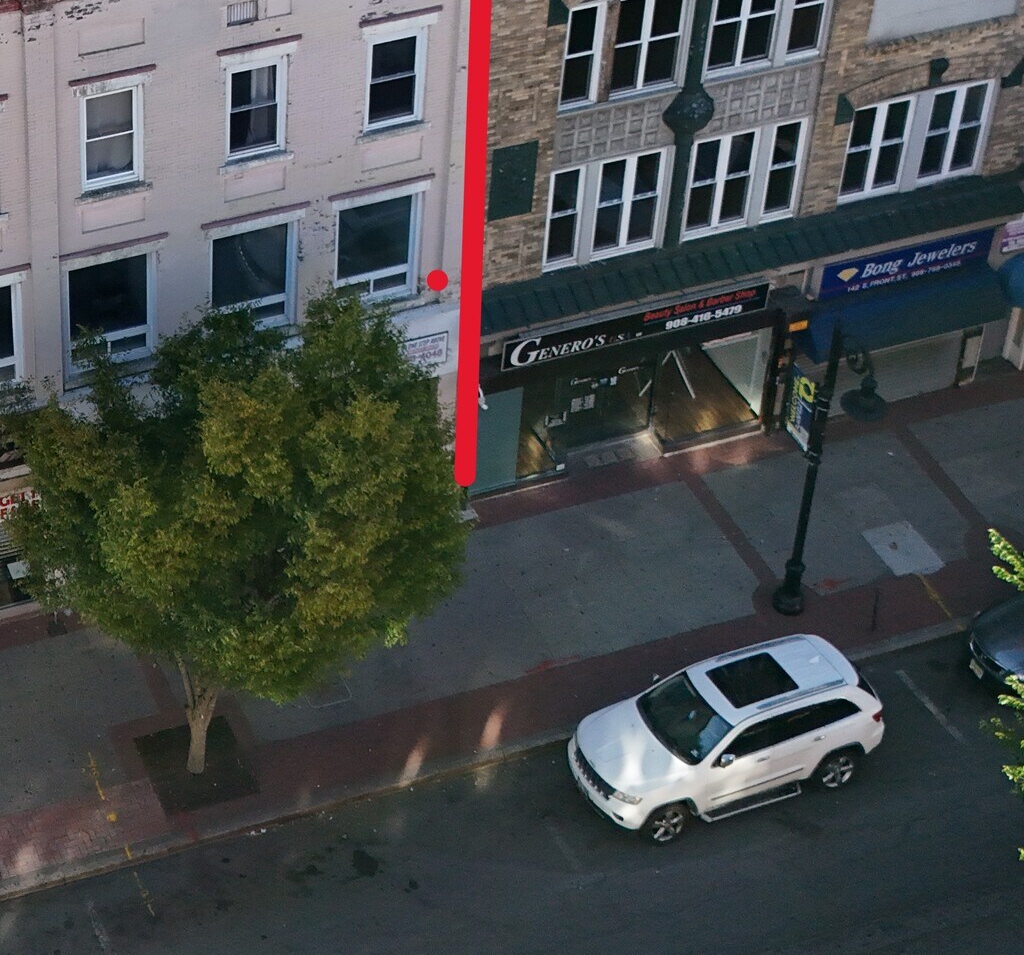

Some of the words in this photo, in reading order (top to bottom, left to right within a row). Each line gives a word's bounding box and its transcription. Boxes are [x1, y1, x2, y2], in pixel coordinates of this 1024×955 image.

[860, 258, 904, 279] Bong
[907, 241, 978, 268] Jewelers
[673, 302, 697, 315] Salon
[697, 300, 705, 309] &
[706, 294, 734, 307] Barber
[510, 334, 606, 366] GENERO'S
